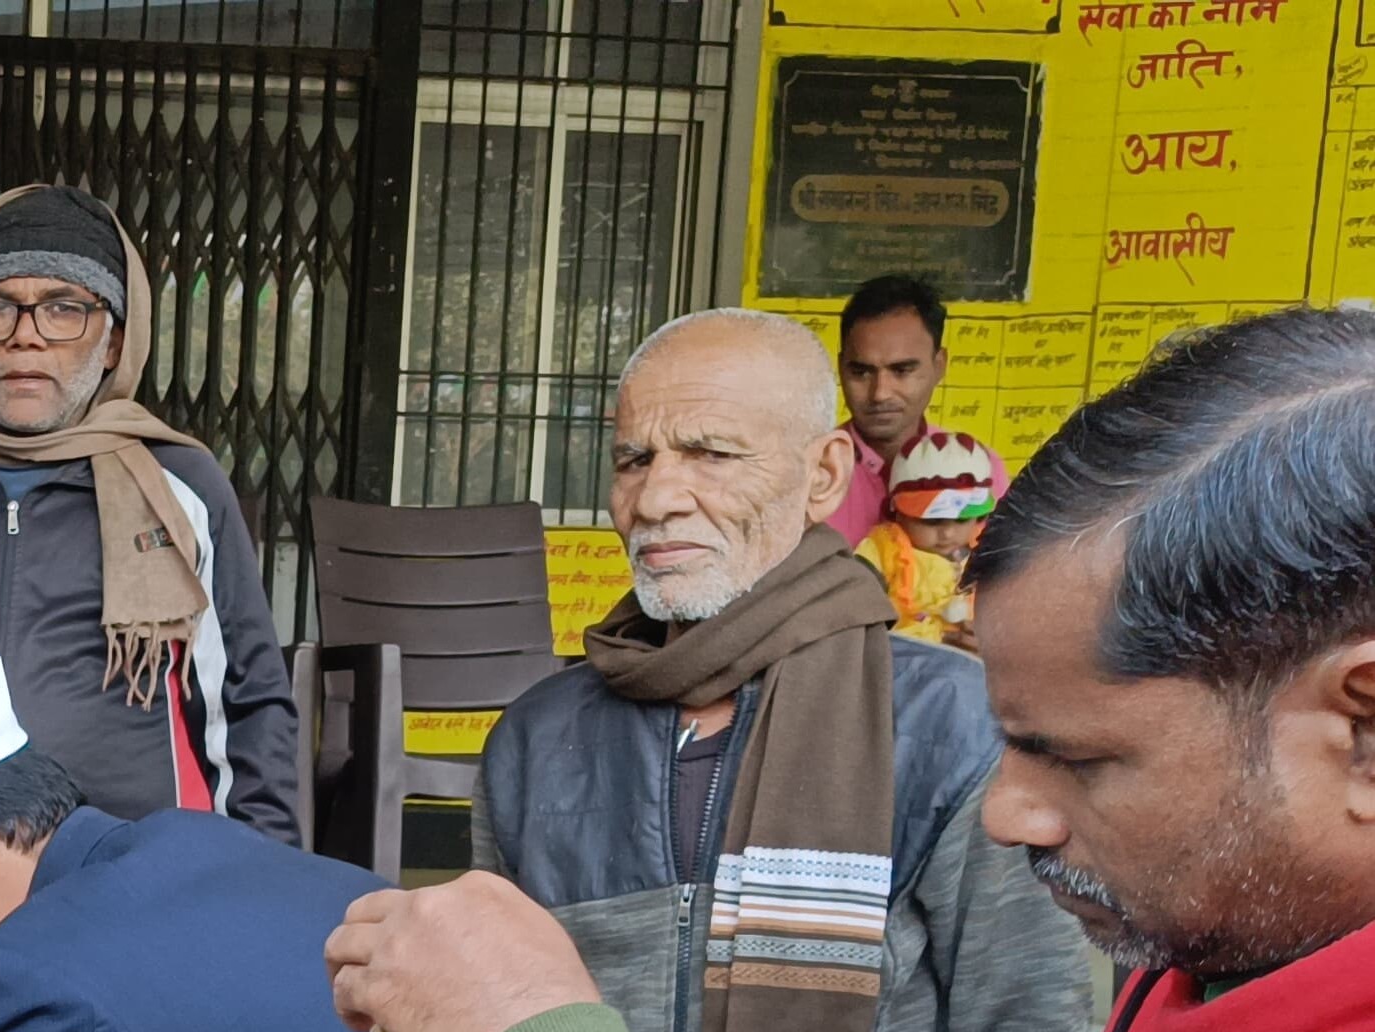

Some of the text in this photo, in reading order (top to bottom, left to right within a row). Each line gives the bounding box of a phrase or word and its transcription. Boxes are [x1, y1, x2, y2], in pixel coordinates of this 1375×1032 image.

[1148, 2, 1195, 30] का
[1202, 0, 1289, 27] नाम
[1104, 212, 1235, 287] आवासीय
